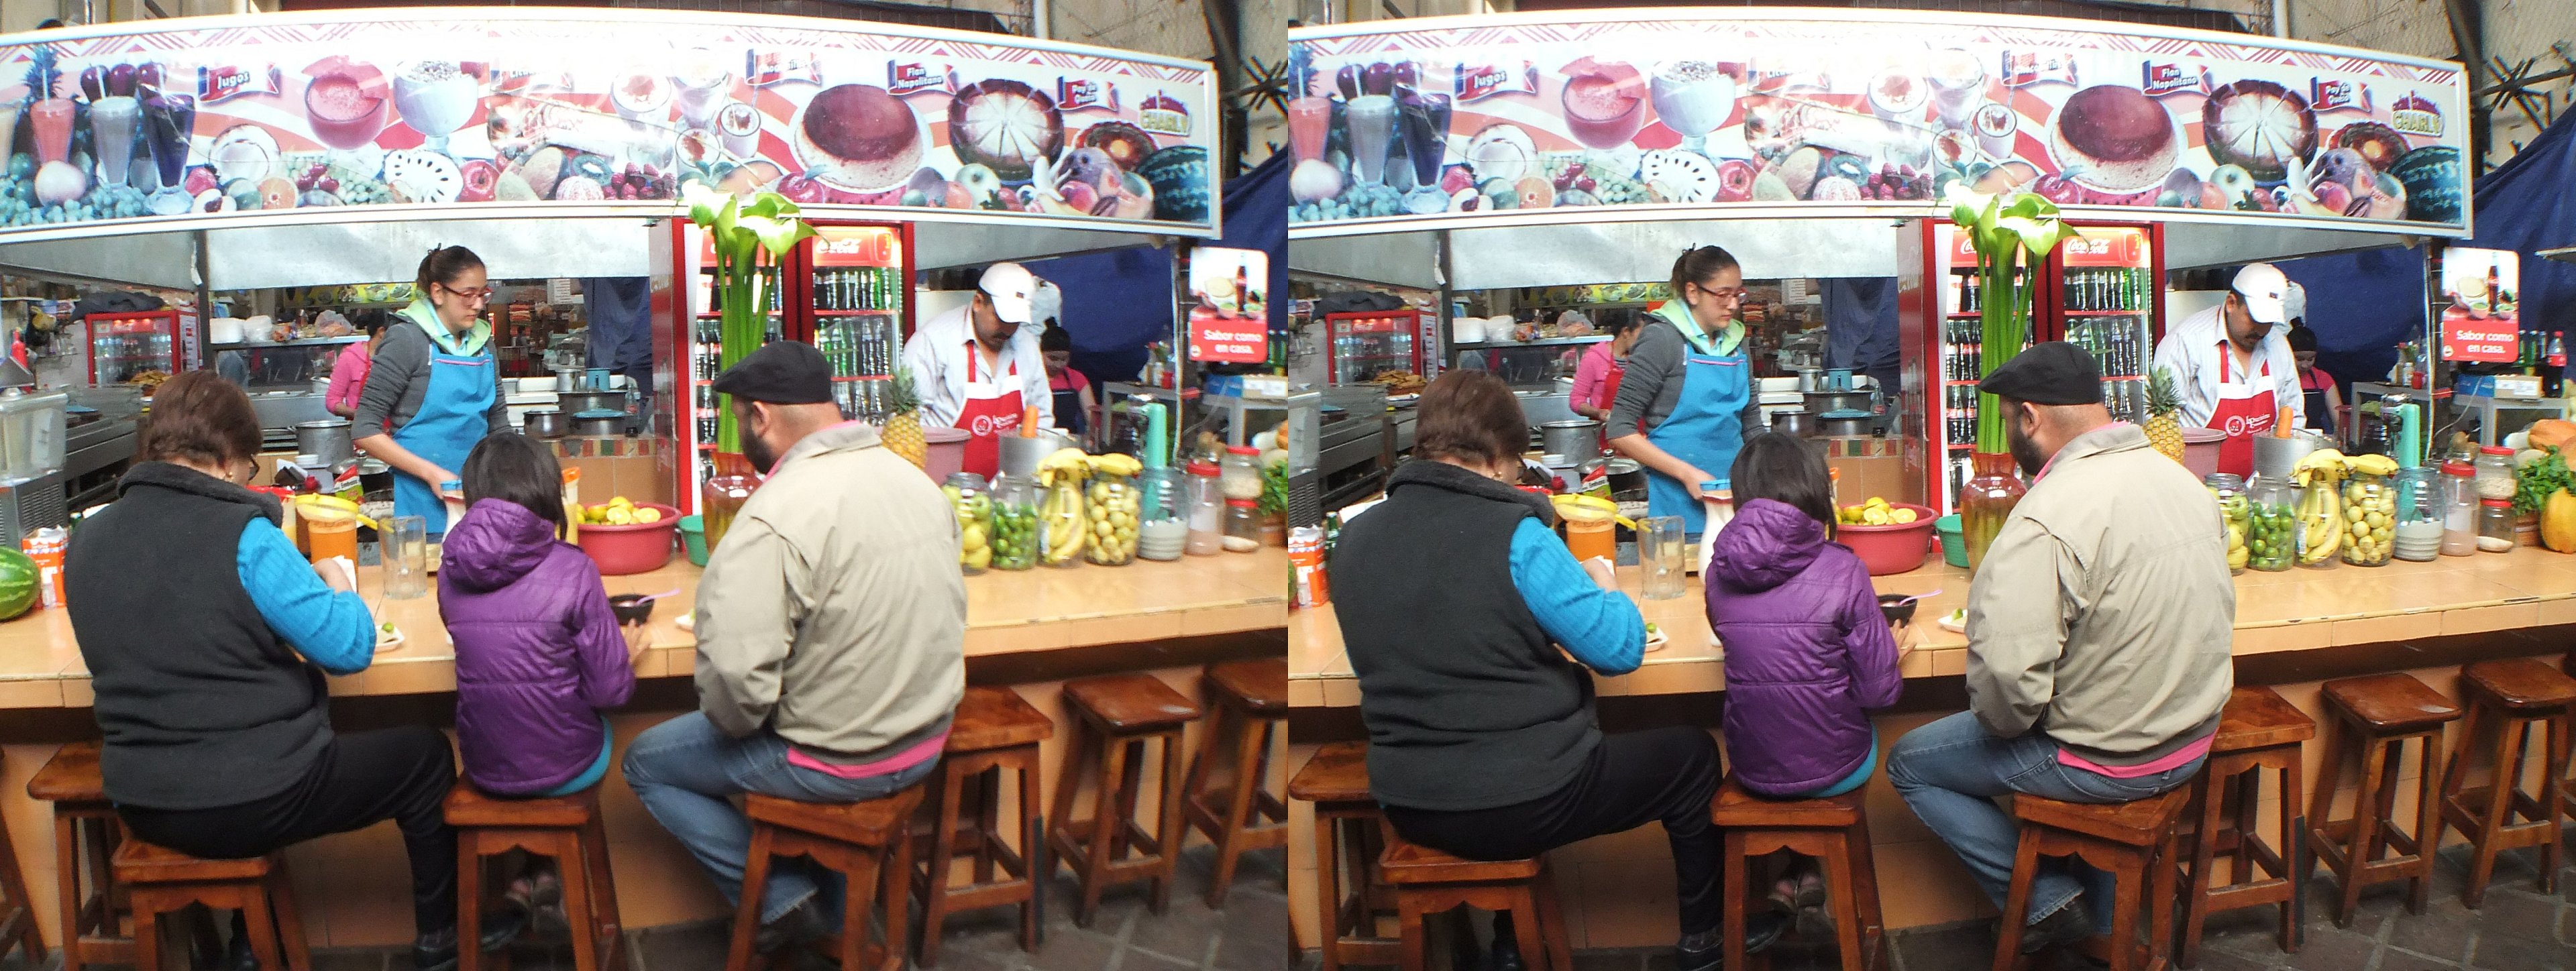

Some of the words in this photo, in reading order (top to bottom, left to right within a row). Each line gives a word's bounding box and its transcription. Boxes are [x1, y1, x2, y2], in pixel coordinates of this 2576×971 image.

[906, 67, 926, 77] Flan
[2162, 67, 2180, 78] Flan
[217, 71, 250, 90] Jugos
[898, 76, 943, 89] Napolitano
[1474, 70, 1507, 89] Jugos
[2153, 76, 2198, 89] Napolitano
[1140, 110, 1188, 133] CHARLY
[2392, 111, 2440, 134] CHARLY
[1203, 329, 1234, 341] Sabor
[1234, 333, 1263, 343] como
[2456, 330, 2486, 341] Sabor
[2486, 333, 2515, 342] como
[1215, 344, 1229, 353] en
[1229, 344, 1254, 354] casa.
[2467, 344, 2481, 353] en
[2481, 345, 2506, 354] casa.
